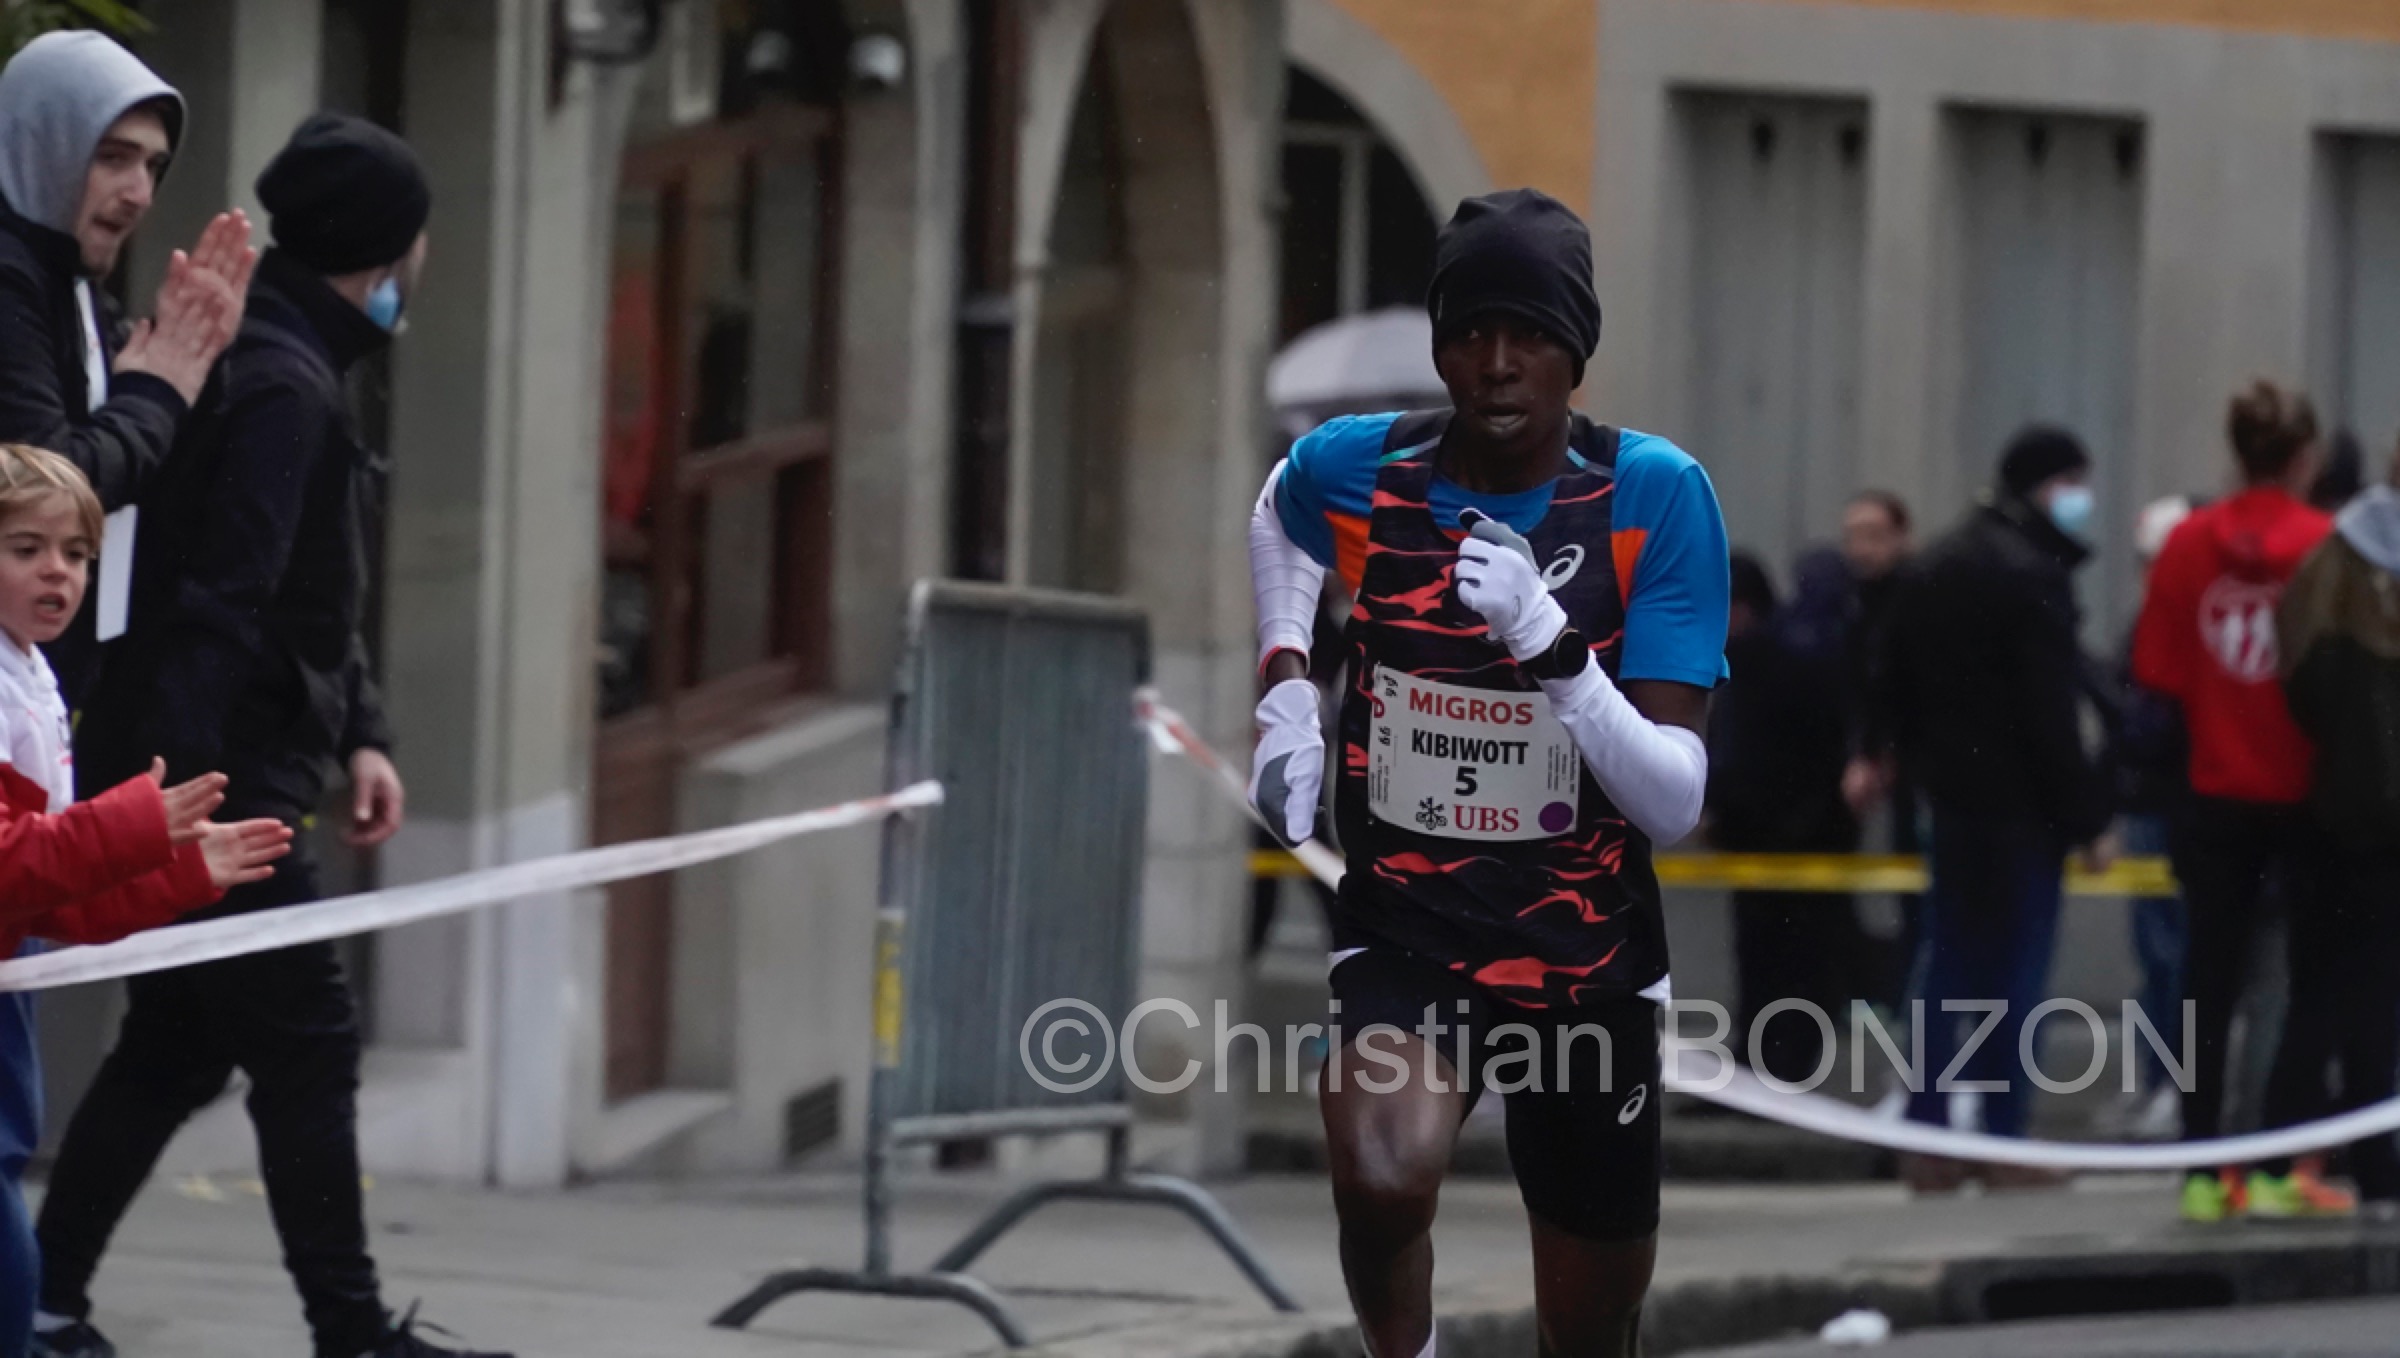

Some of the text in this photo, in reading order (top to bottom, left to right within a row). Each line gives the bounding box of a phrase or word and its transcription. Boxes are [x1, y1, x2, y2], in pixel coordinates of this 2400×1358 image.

[1409, 687, 1533, 725] MIGROS
[1411, 728, 1529, 765] KIBIWOTT
[1453, 766, 1478, 796] 5
[1453, 803, 1519, 832] UBS
